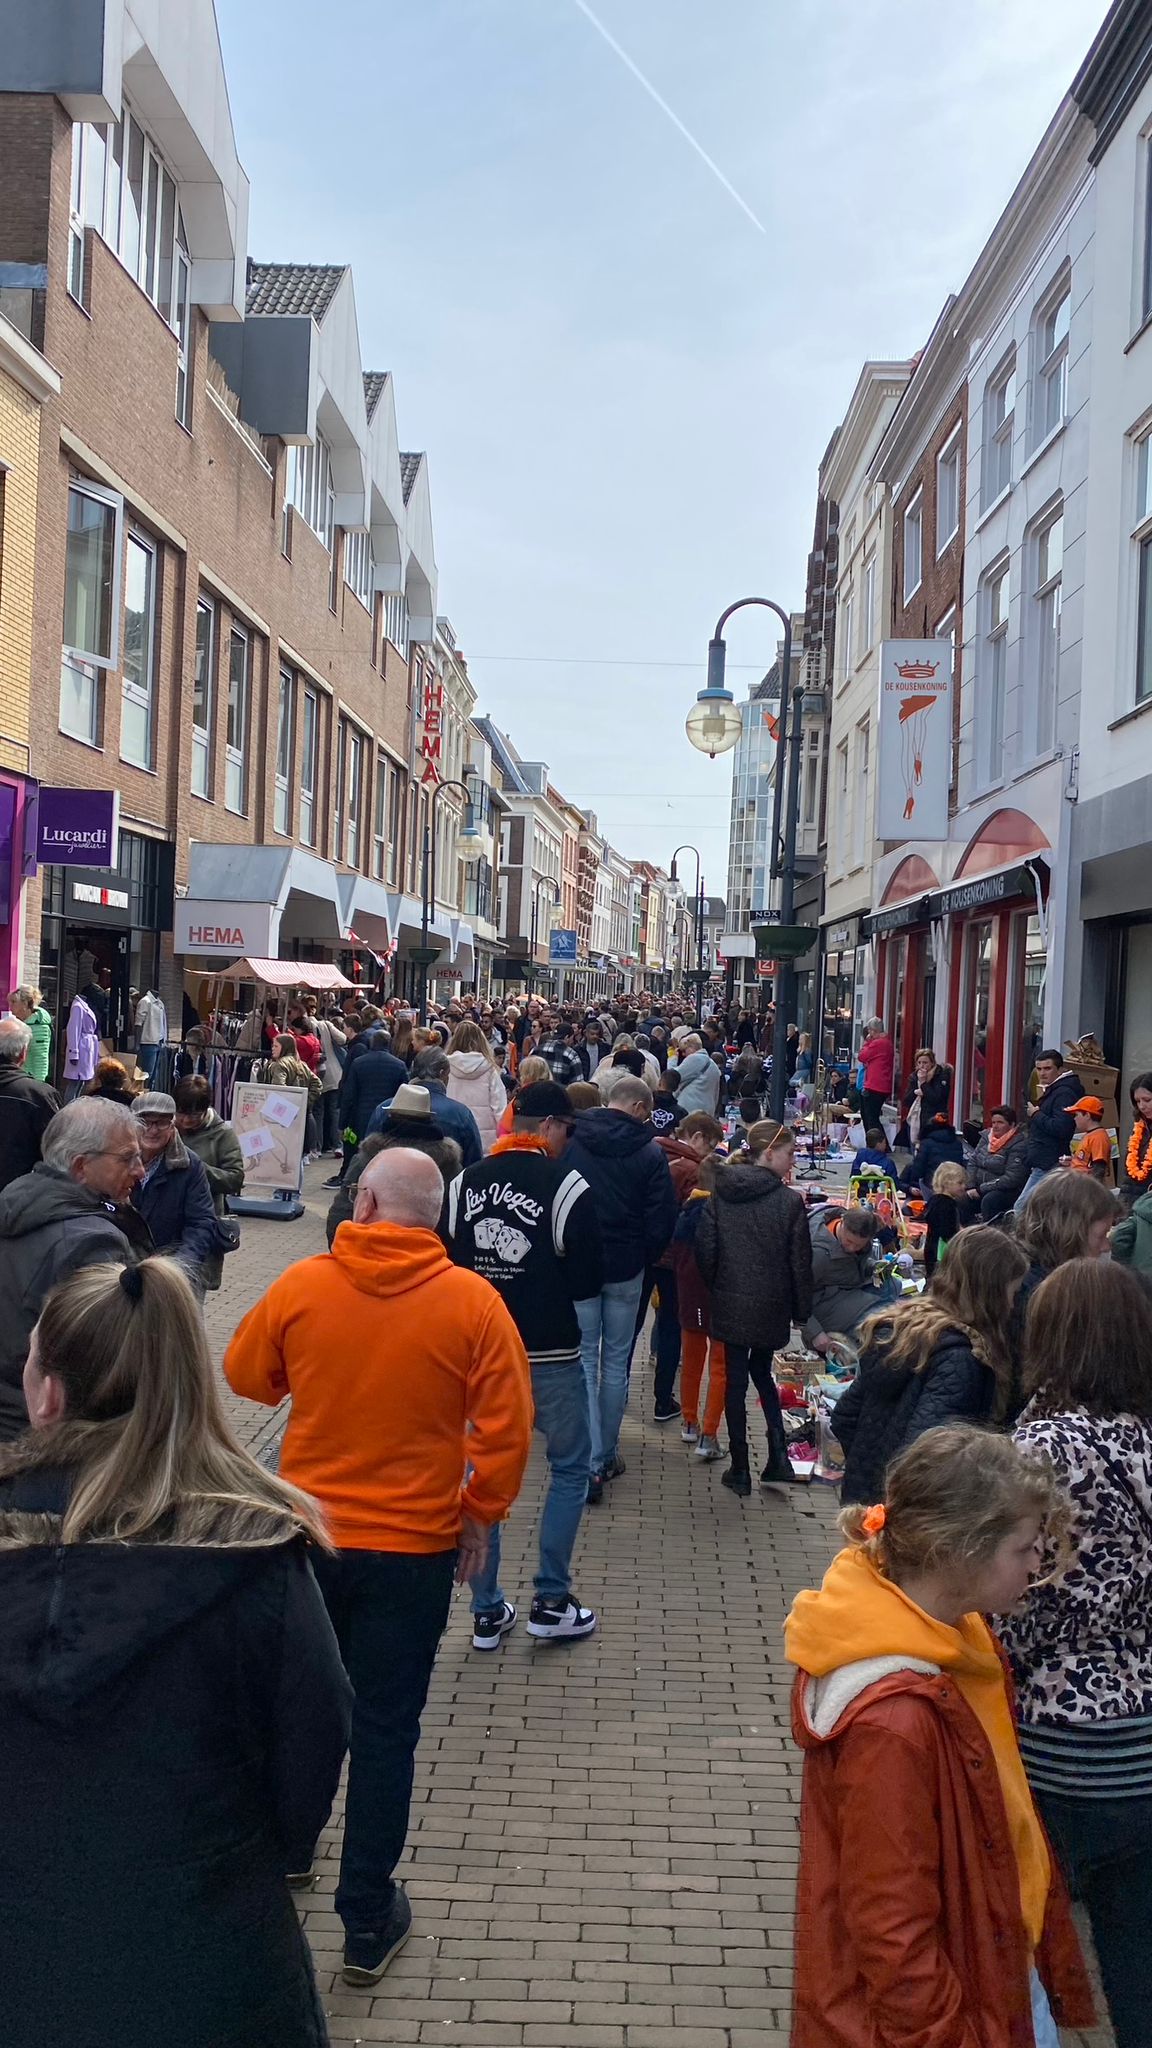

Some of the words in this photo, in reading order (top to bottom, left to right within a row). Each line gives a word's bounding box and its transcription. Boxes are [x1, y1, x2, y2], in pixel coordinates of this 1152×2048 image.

[885, 682, 894, 691] DE
[895, 682, 948, 691] KOUSENKONING
[421, 685, 444, 784] HEMA
[42, 826, 107, 843] Lucardi
[941, 894, 950, 912] DE
[950, 876, 1004, 909] KOUSENKONING
[188, 926, 245, 945] HEMA
[436, 969, 463, 978] HEMA
[464, 1188, 487, 1221] Las
[489, 1182, 544, 1224] Vegas
